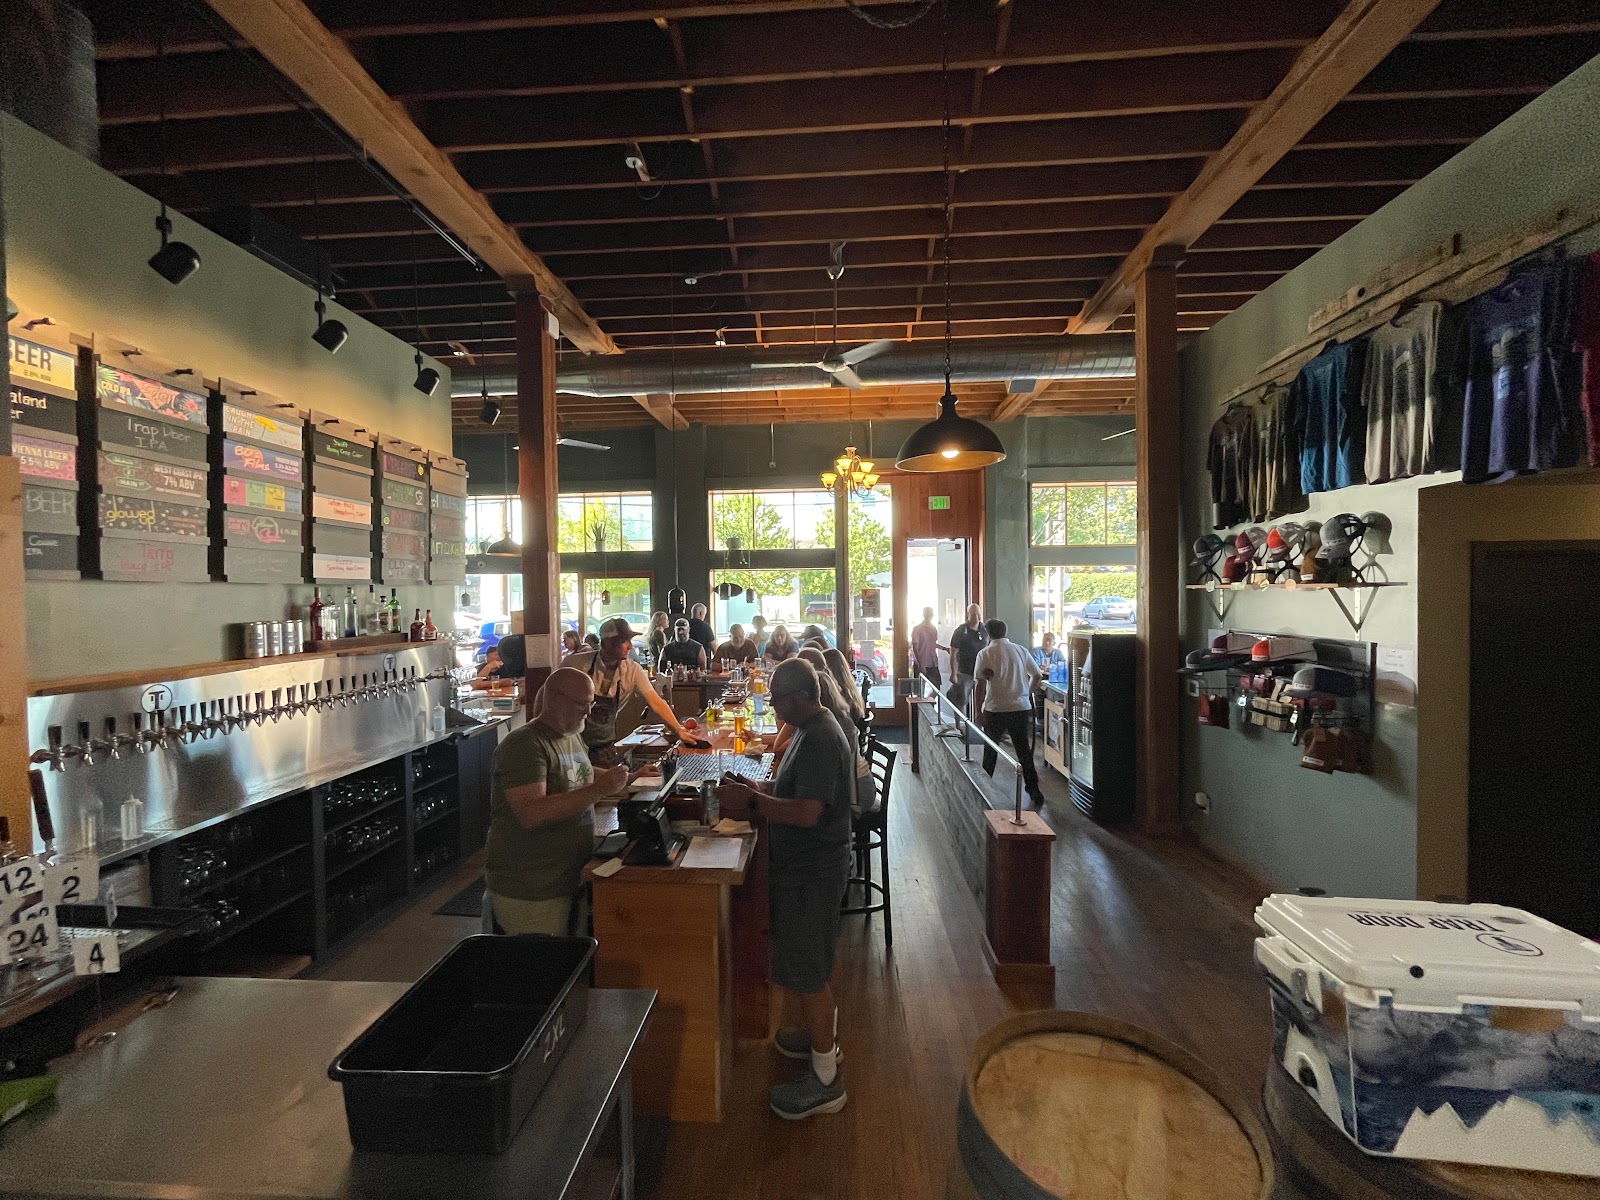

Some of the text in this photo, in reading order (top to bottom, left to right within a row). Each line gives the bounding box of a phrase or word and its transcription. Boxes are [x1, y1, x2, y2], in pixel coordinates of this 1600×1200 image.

[101, 380, 131, 396] COLD IPA
[125, 416, 191, 441] Trap Door
[229, 415, 255, 429] IN THE
[232, 426, 251, 437] RAIN
[134, 436, 169, 451] IPA
[12, 443, 69, 461] VIENNA LAGER
[43, 458, 60, 470] ABV
[154, 464, 171, 474] WEST
[193, 471, 204, 480] IPA
[179, 478, 195, 490] ABV
[106, 495, 156, 522] glowed
[0, 866, 36, 894] 12
[62, 875, 81, 899] 2
[1347, 913, 1426, 929] DOOR
[1427, 917, 1506, 933] TRAP
[7, 923, 49, 956] 24
[89, 942, 105, 962] 4
